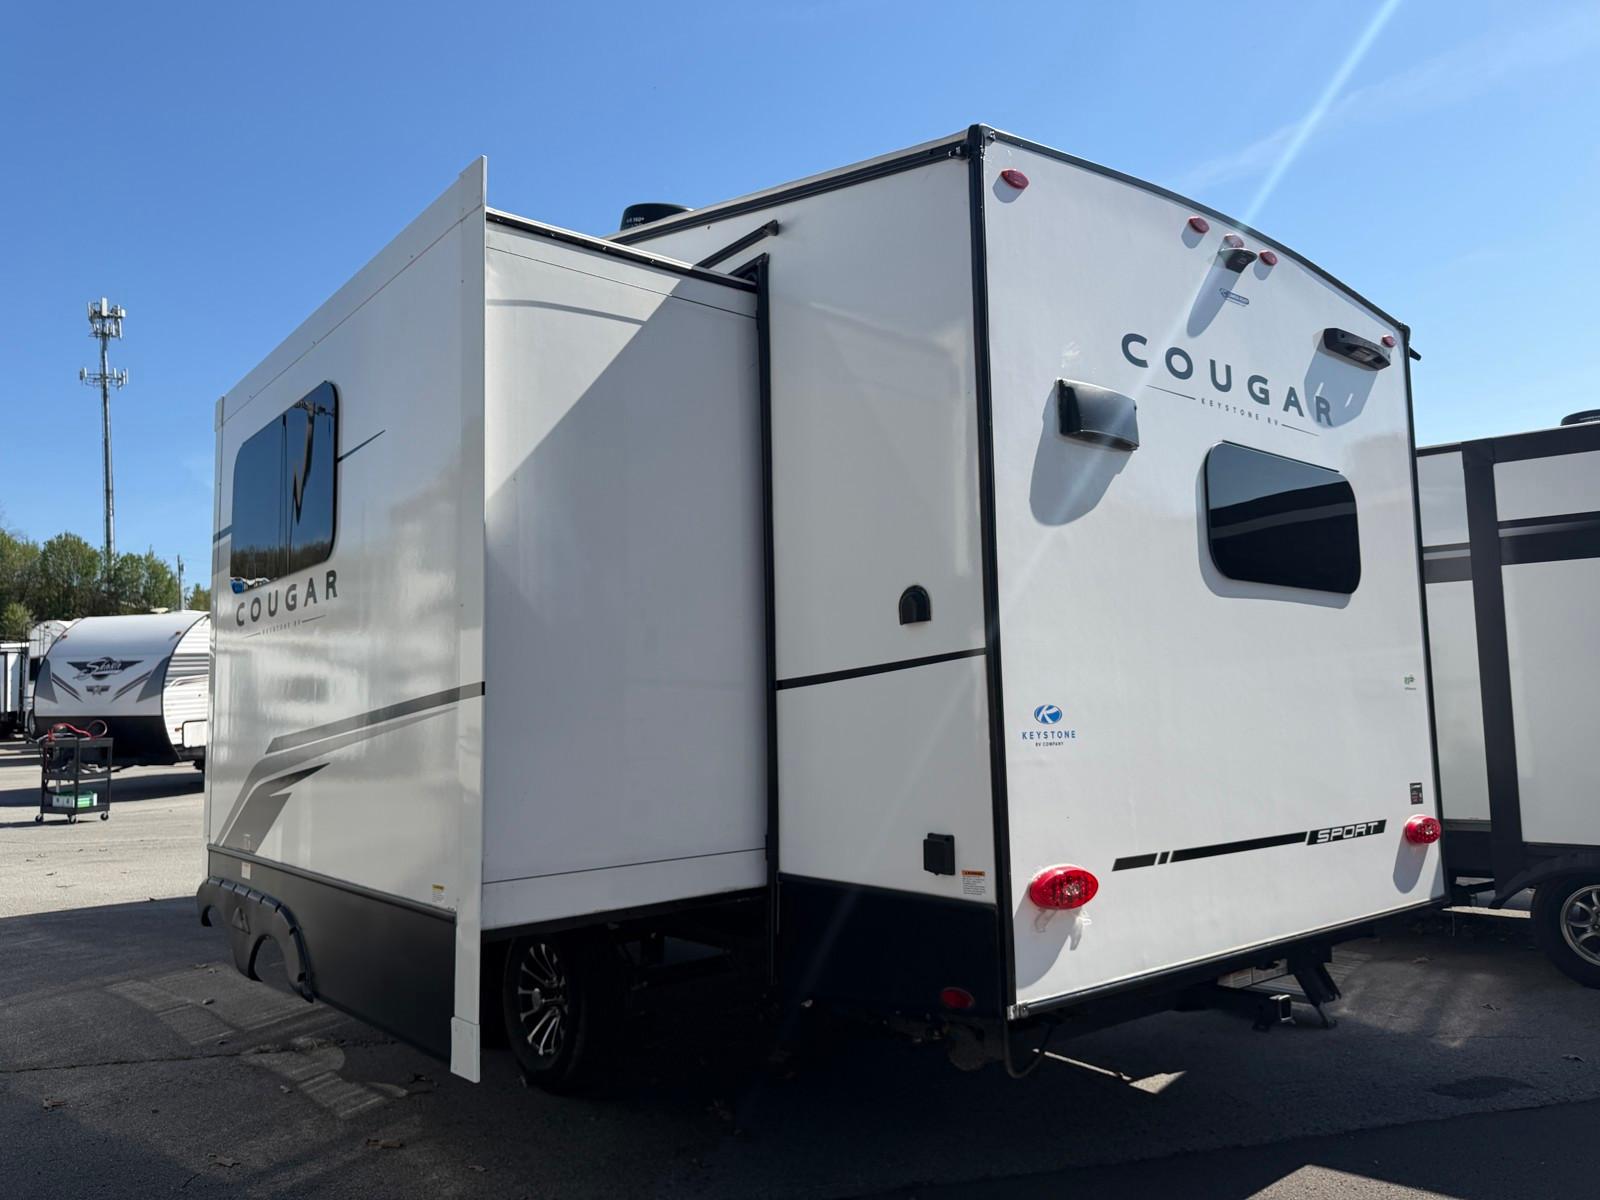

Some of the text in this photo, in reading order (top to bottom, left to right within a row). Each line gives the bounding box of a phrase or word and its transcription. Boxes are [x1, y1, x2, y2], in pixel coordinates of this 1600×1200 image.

[1121, 333, 1333, 426] COUGAR
[1201, 398, 1260, 420] KEYSTONE
[236, 569, 338, 627] COUGAR
[1022, 730, 1076, 740] KEYSTONE
[1316, 821, 1379, 843] SPORT
